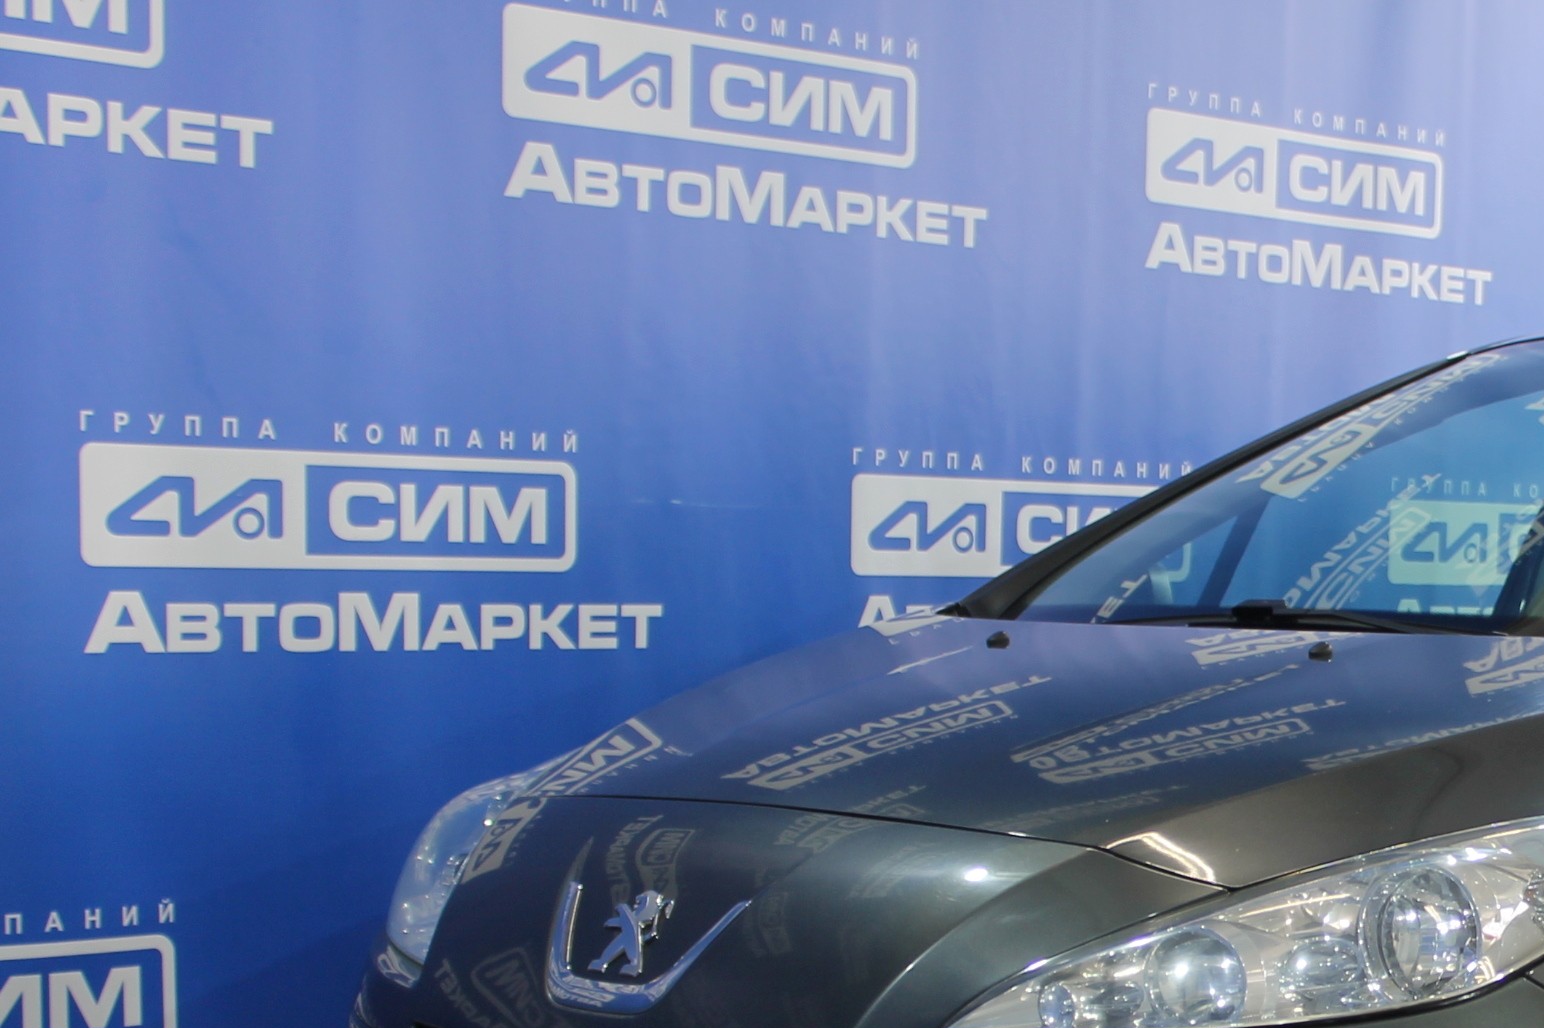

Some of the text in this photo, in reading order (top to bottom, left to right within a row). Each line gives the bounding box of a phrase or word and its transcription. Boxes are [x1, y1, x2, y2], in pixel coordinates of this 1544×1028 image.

[715, 9, 921, 60] КОМПАНИЙ
[709, 63, 893, 141] СИМ
[1148, 83, 1446, 147] ГРУППА КОМПАНИЙ
[1289, 154, 1425, 217] СИМ
[80, 410, 578, 454] ГРУППА КОМПАНИЙ
[853, 447, 1192, 480] ГРУППА КОМПАНИЙ
[329, 481, 547, 544] СИМ
